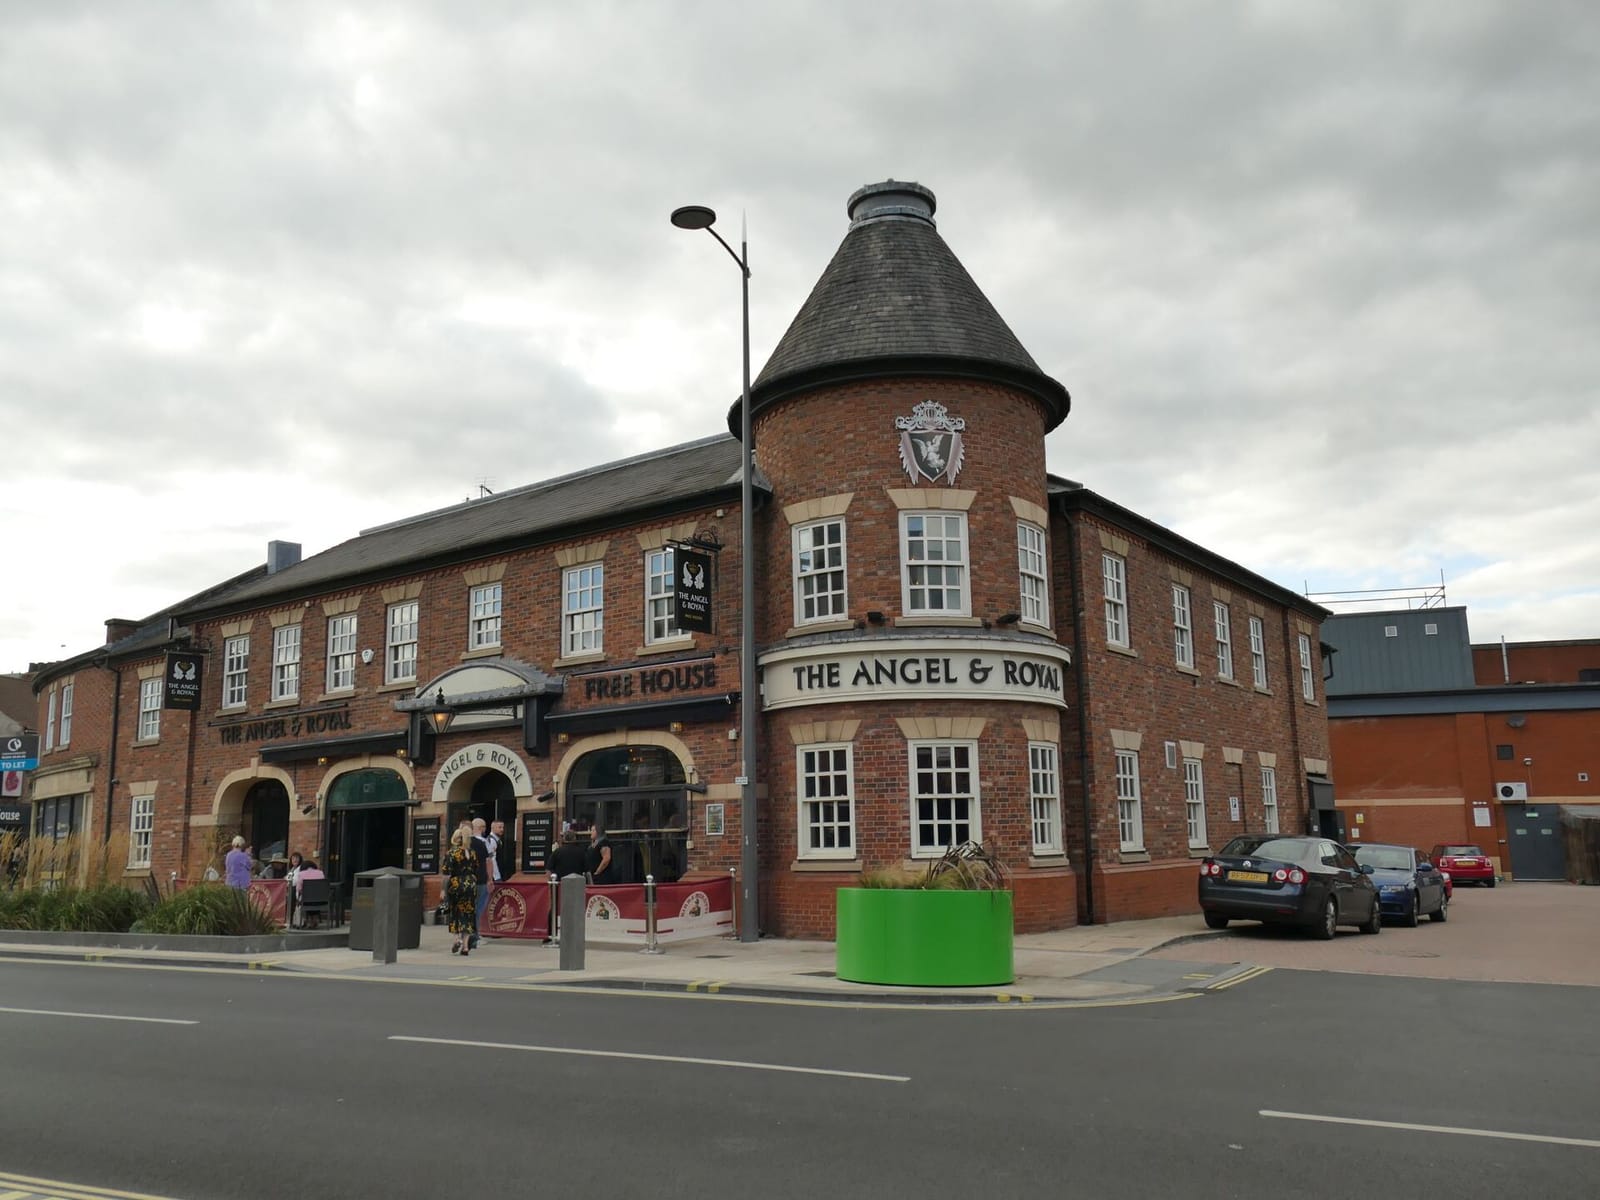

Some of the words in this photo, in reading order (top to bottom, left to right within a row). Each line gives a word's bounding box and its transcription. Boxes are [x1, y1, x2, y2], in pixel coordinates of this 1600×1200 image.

[679, 591, 689, 600] THE
[585, 673, 633, 700] FREE
[640, 662, 716, 694] HOUSE
[793, 662, 840, 690] THE
[852, 658, 957, 686] ANGEL
[969, 658, 993, 684] &
[1003, 660, 1060, 691] ROYAL
[219, 726, 242, 745] THE
[246, 719, 286, 742] ANGEL
[291, 716, 302, 736] &
[306, 710, 352, 734] ROYAL
[439, 752, 472, 789] ANGEL
[476, 749, 485, 761] &
[491, 750, 523, 783] ROYAL
[0, 808, 20, 820] ouse
